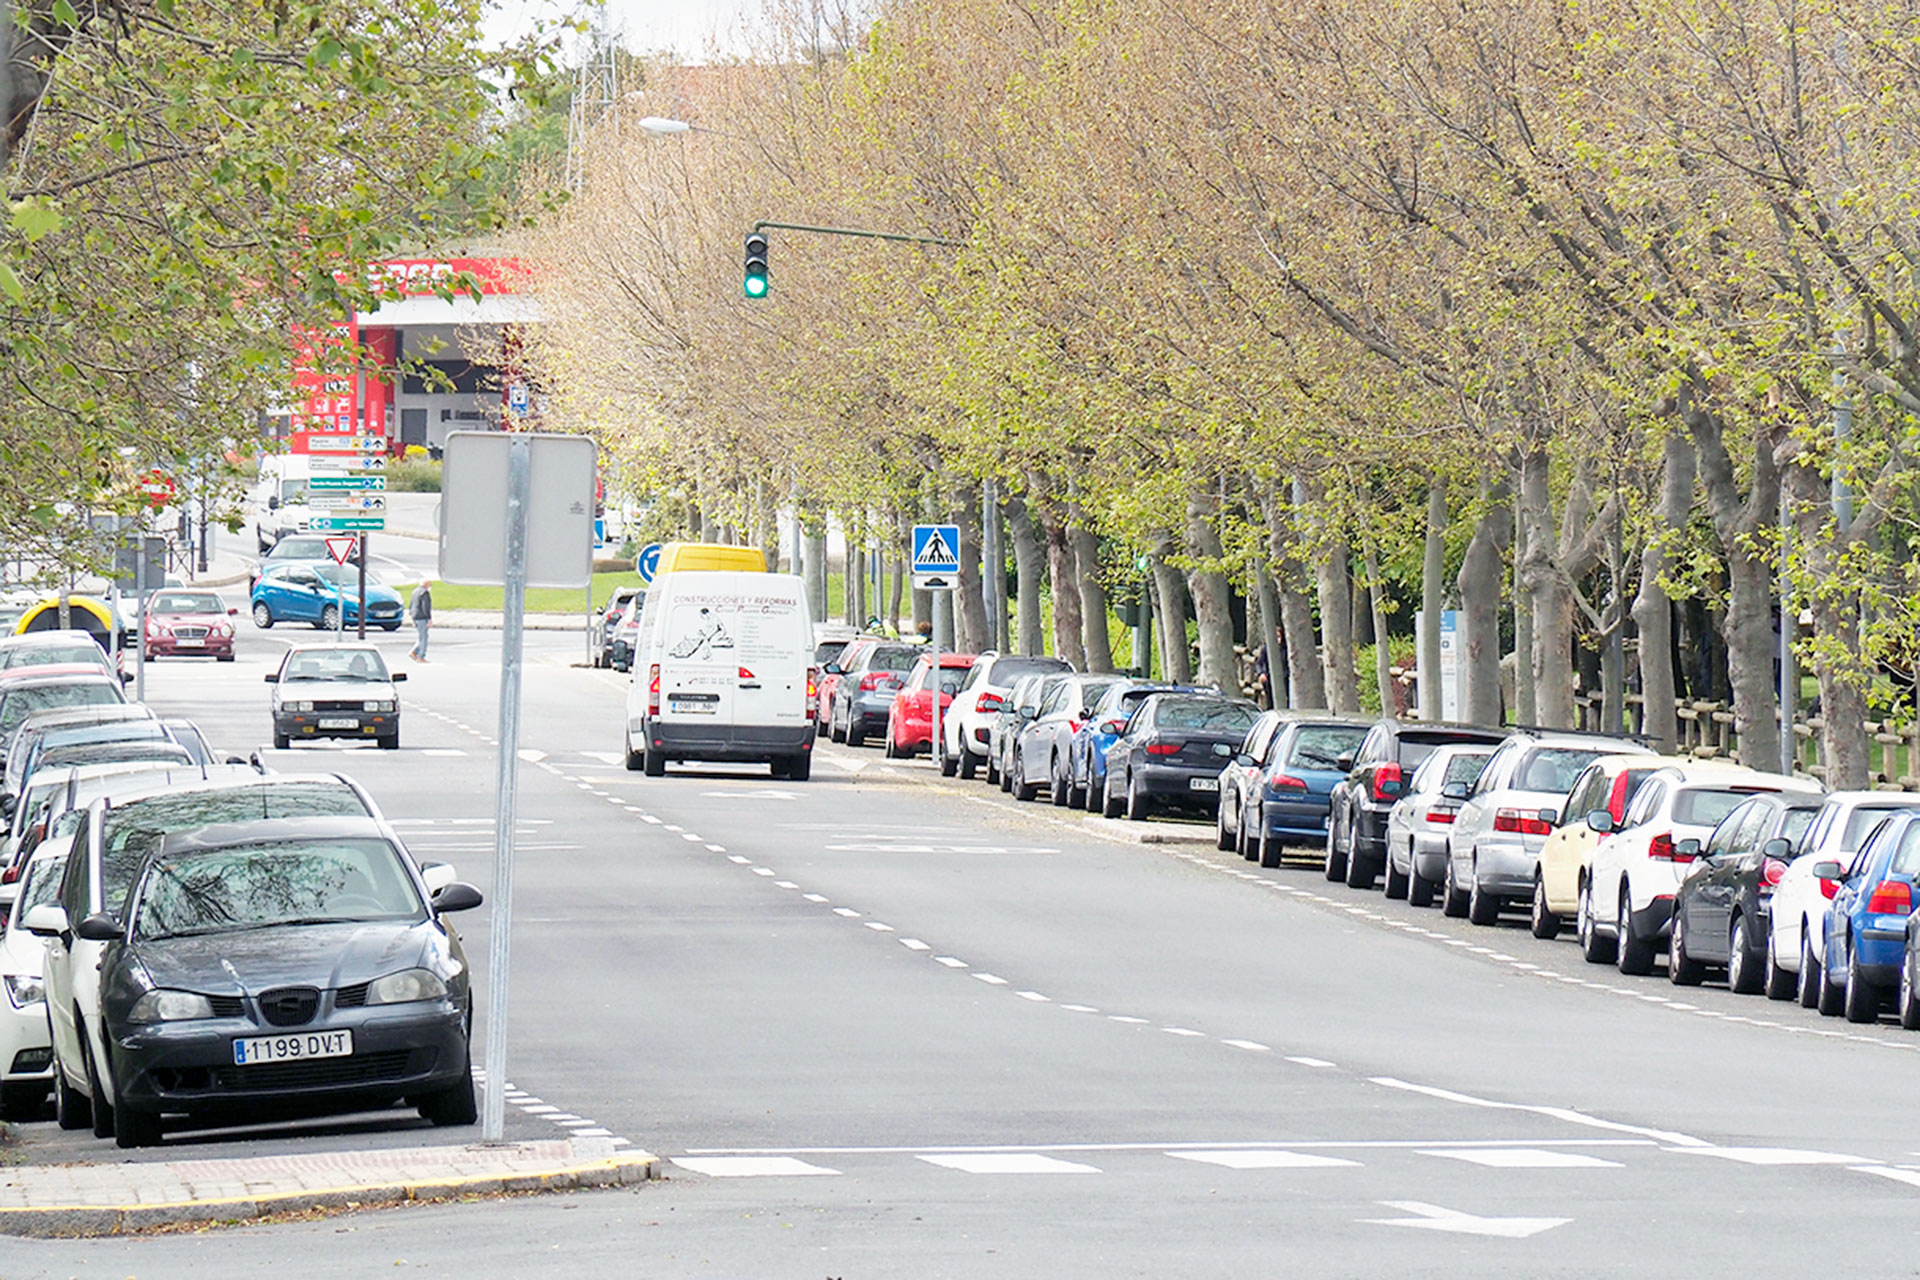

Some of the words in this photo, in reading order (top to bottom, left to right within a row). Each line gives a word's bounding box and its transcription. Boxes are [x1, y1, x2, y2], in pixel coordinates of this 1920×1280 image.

[674, 595, 745, 604] CONSTRUCCIONES
[754, 597, 797, 606] REFORMAS
[251, 1038, 300, 1060] 1199
[308, 1034, 345, 1055] DVT
